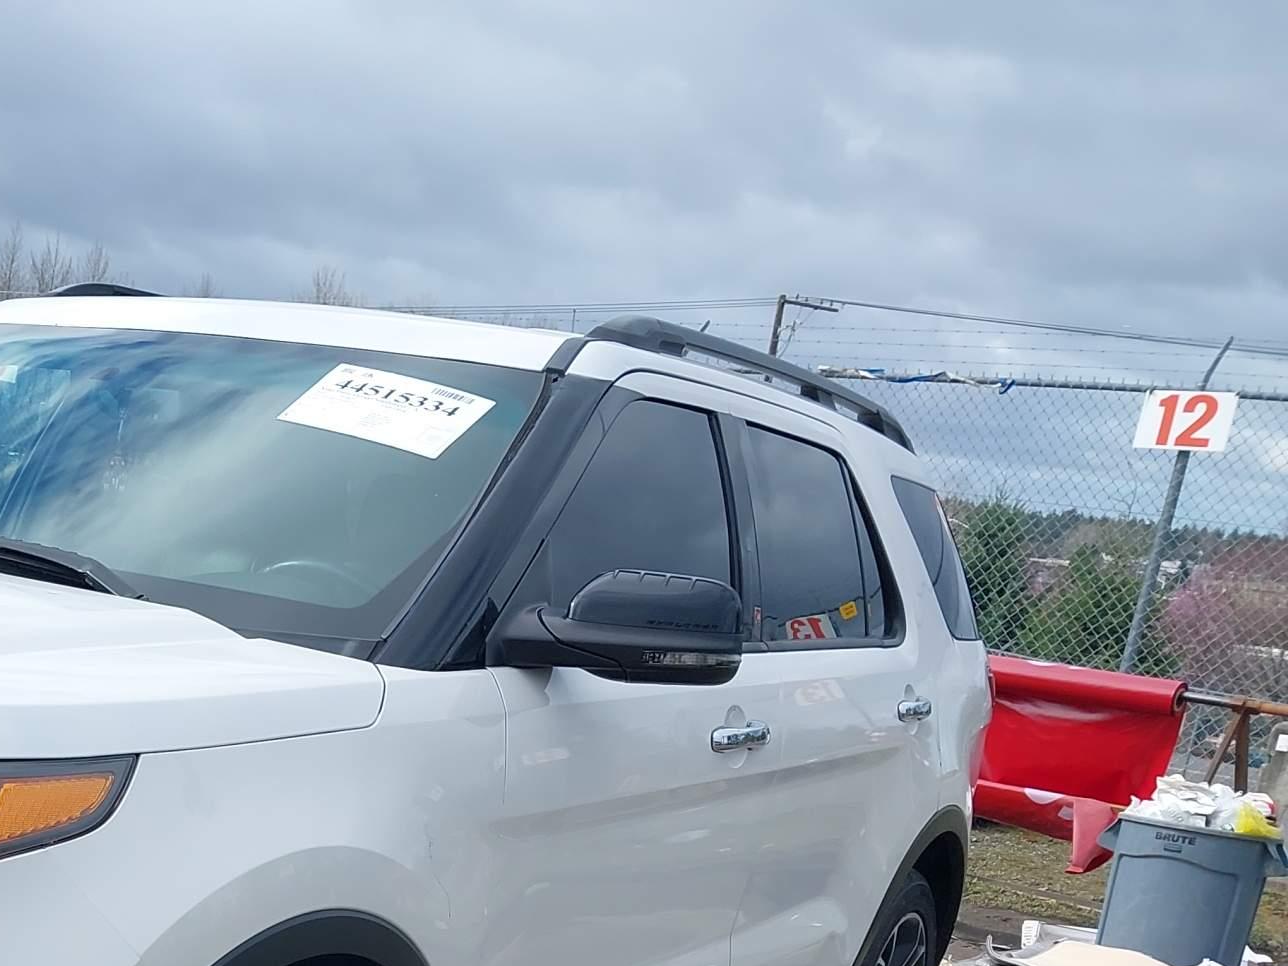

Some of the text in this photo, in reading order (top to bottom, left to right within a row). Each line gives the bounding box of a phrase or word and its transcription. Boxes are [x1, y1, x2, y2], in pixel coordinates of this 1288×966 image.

[335, 379, 460, 417] 44515334
[1155, 394, 1218, 448] 12
[1155, 831, 1198, 846] BRUTE
